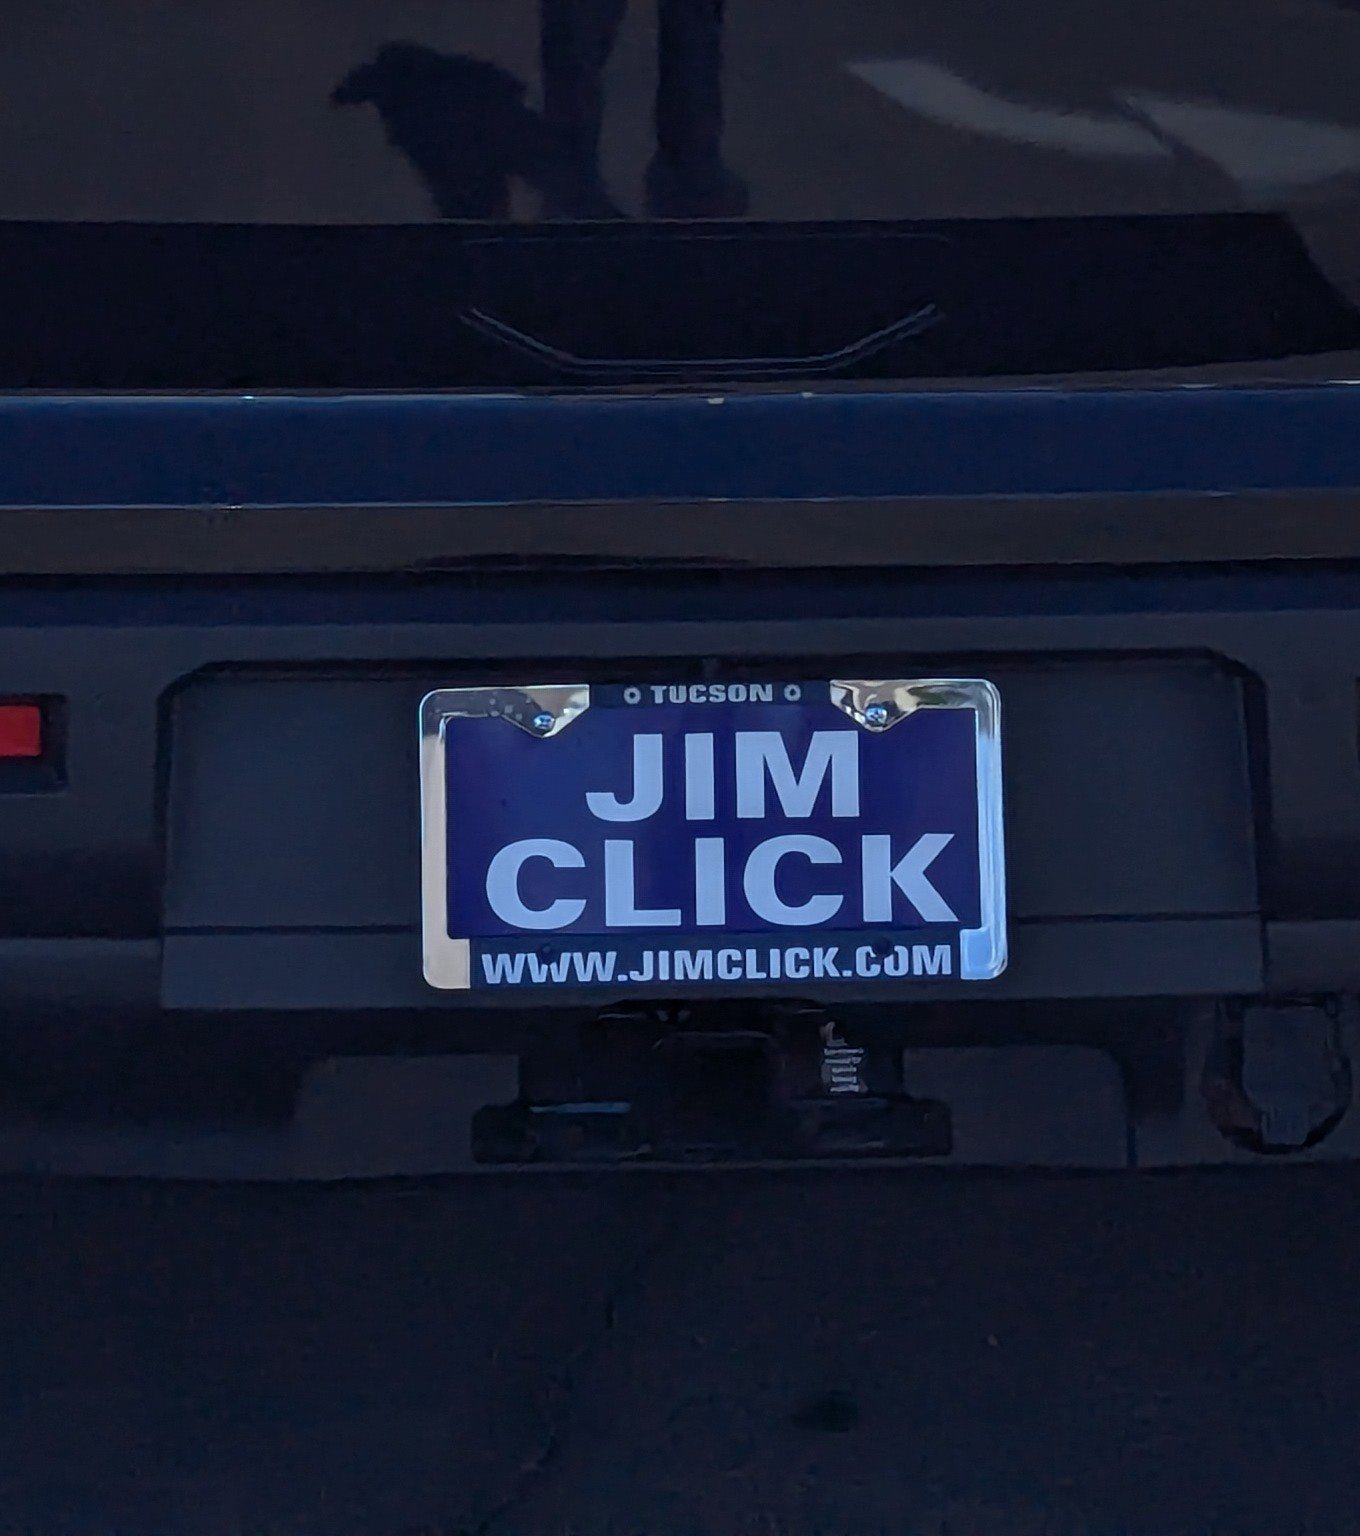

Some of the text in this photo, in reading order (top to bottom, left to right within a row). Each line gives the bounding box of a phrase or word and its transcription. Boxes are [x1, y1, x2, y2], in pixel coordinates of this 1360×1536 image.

[650, 683, 773, 705] TUCSON
[585, 729, 861, 822] JIM
[485, 833, 960, 930] CLICK
[481, 944, 952, 984] WWW.JIMCLICK.COM
